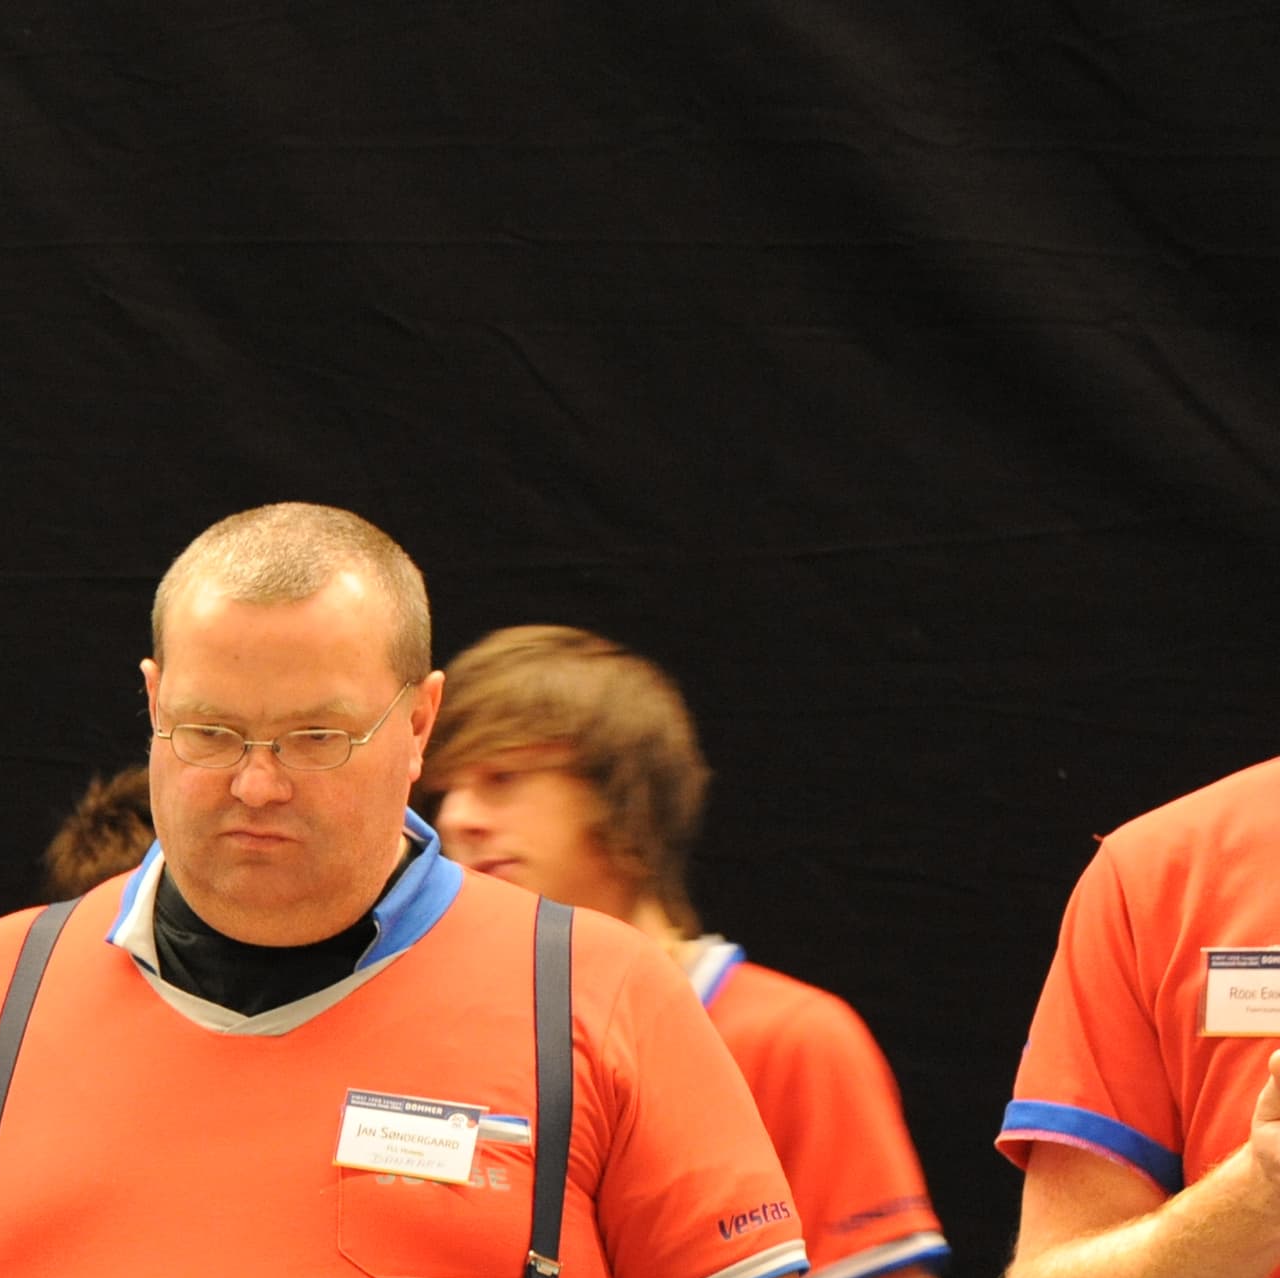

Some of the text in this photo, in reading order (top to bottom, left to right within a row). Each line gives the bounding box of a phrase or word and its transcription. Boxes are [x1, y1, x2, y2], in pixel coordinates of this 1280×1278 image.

[404, 1102, 443, 1115] DOMMER
[356, 1124, 461, 1150] JAN SØNDERGAARD
[717, 1200, 791, 1240] Vestas
